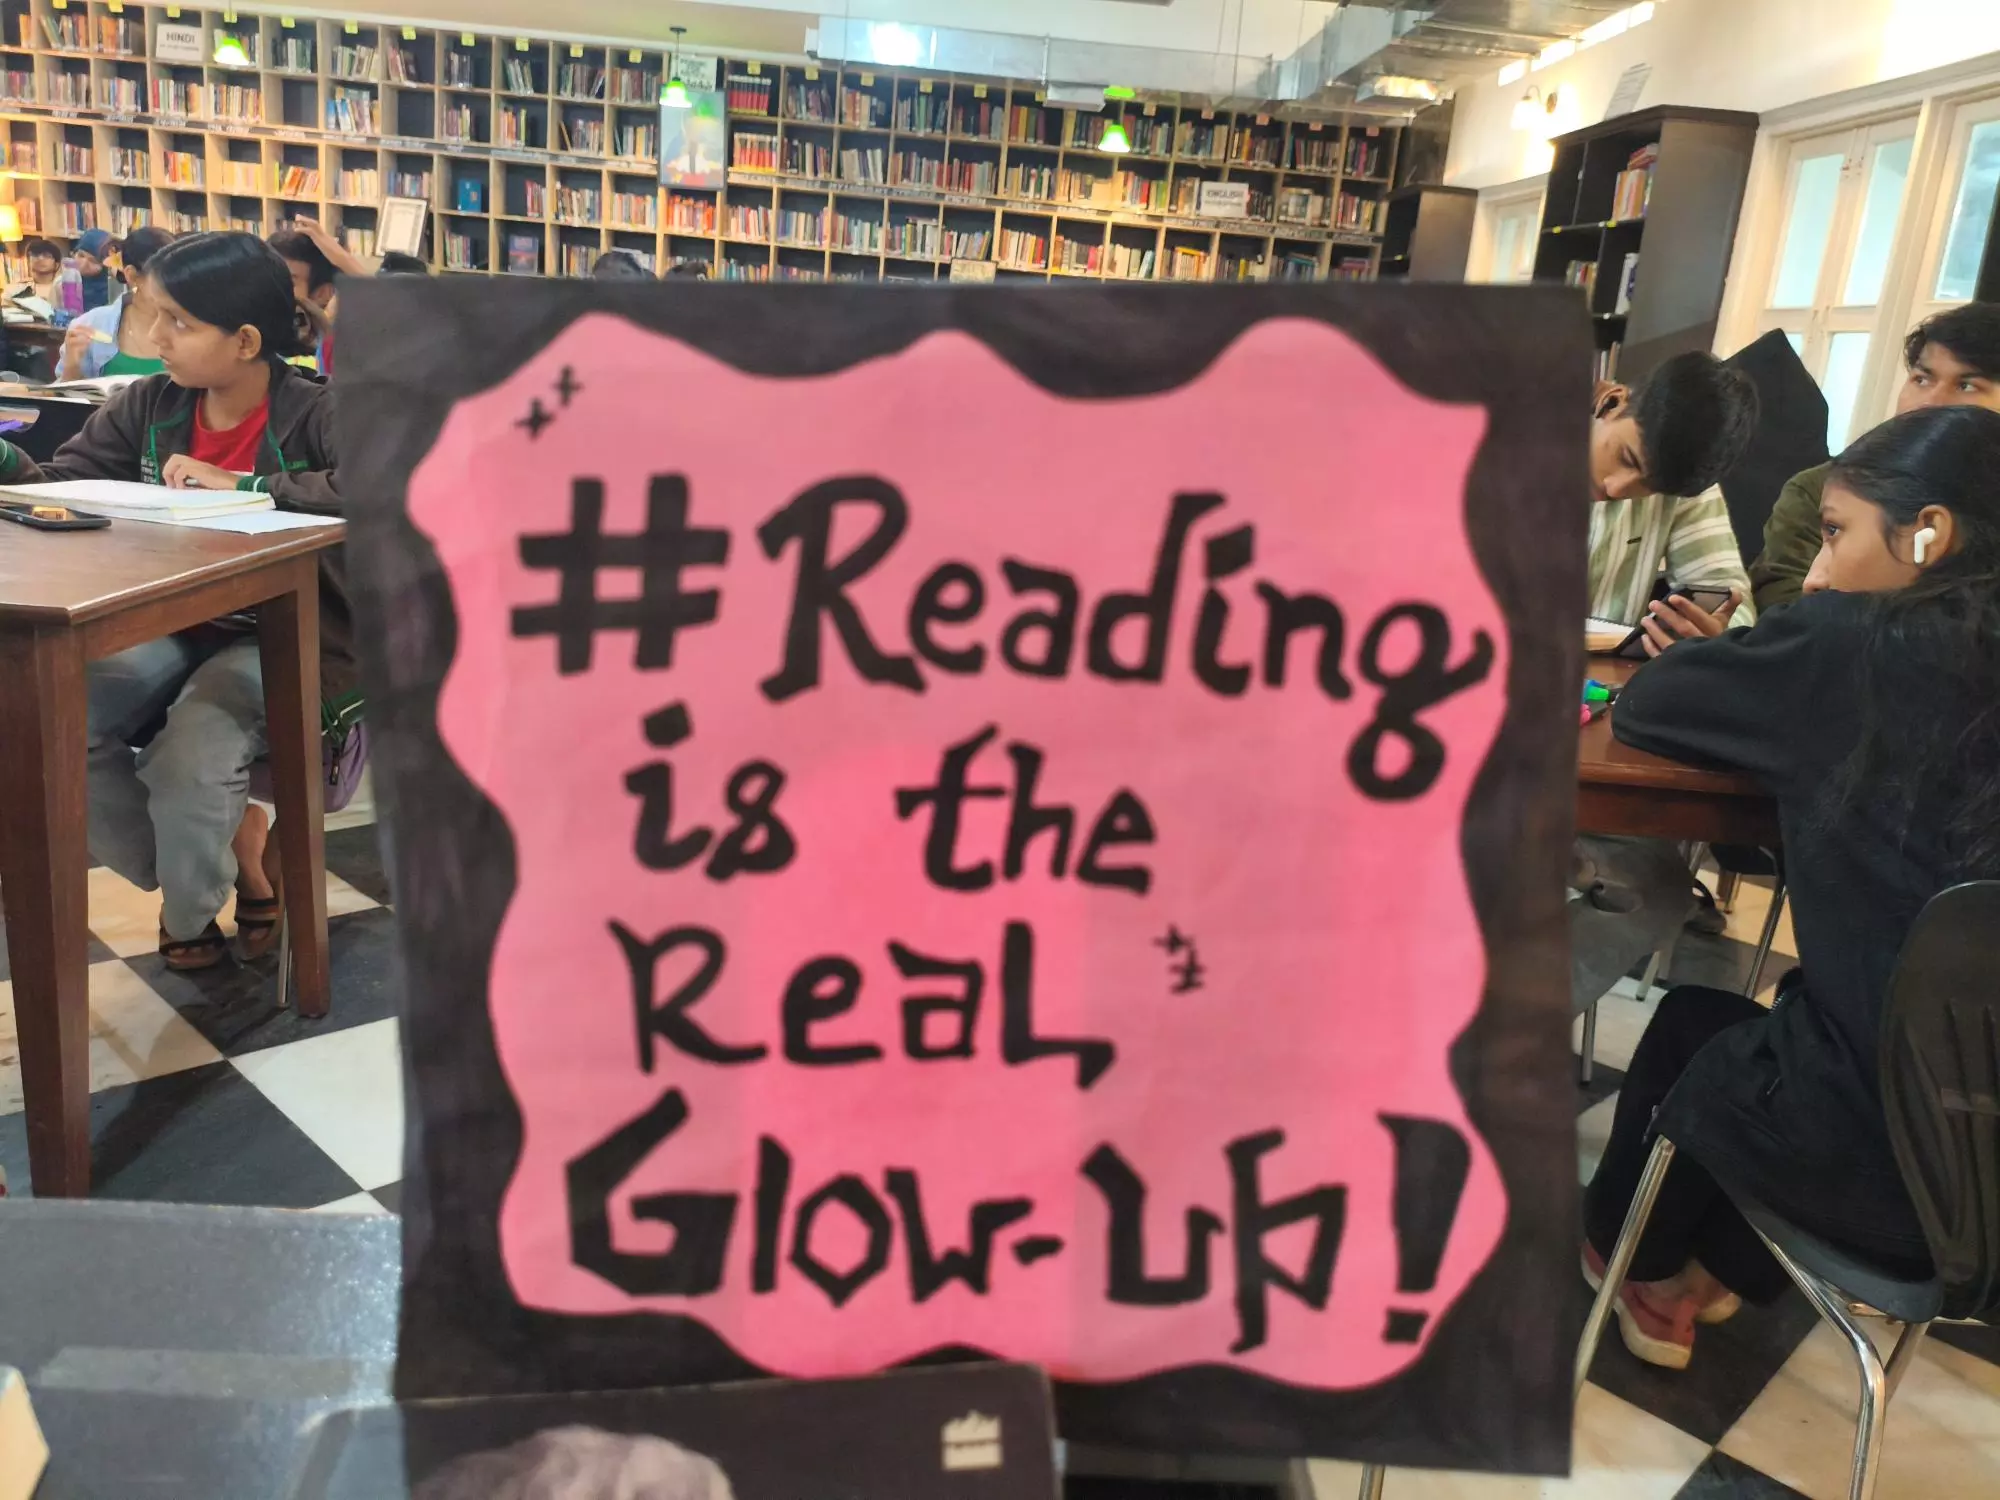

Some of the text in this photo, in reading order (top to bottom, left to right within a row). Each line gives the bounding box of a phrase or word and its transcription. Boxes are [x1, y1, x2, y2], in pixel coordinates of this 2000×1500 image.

[166, 32, 195, 44] HINDI
[510, 473, 1495, 804] #Reading
[621, 699, 1157, 898] is the
